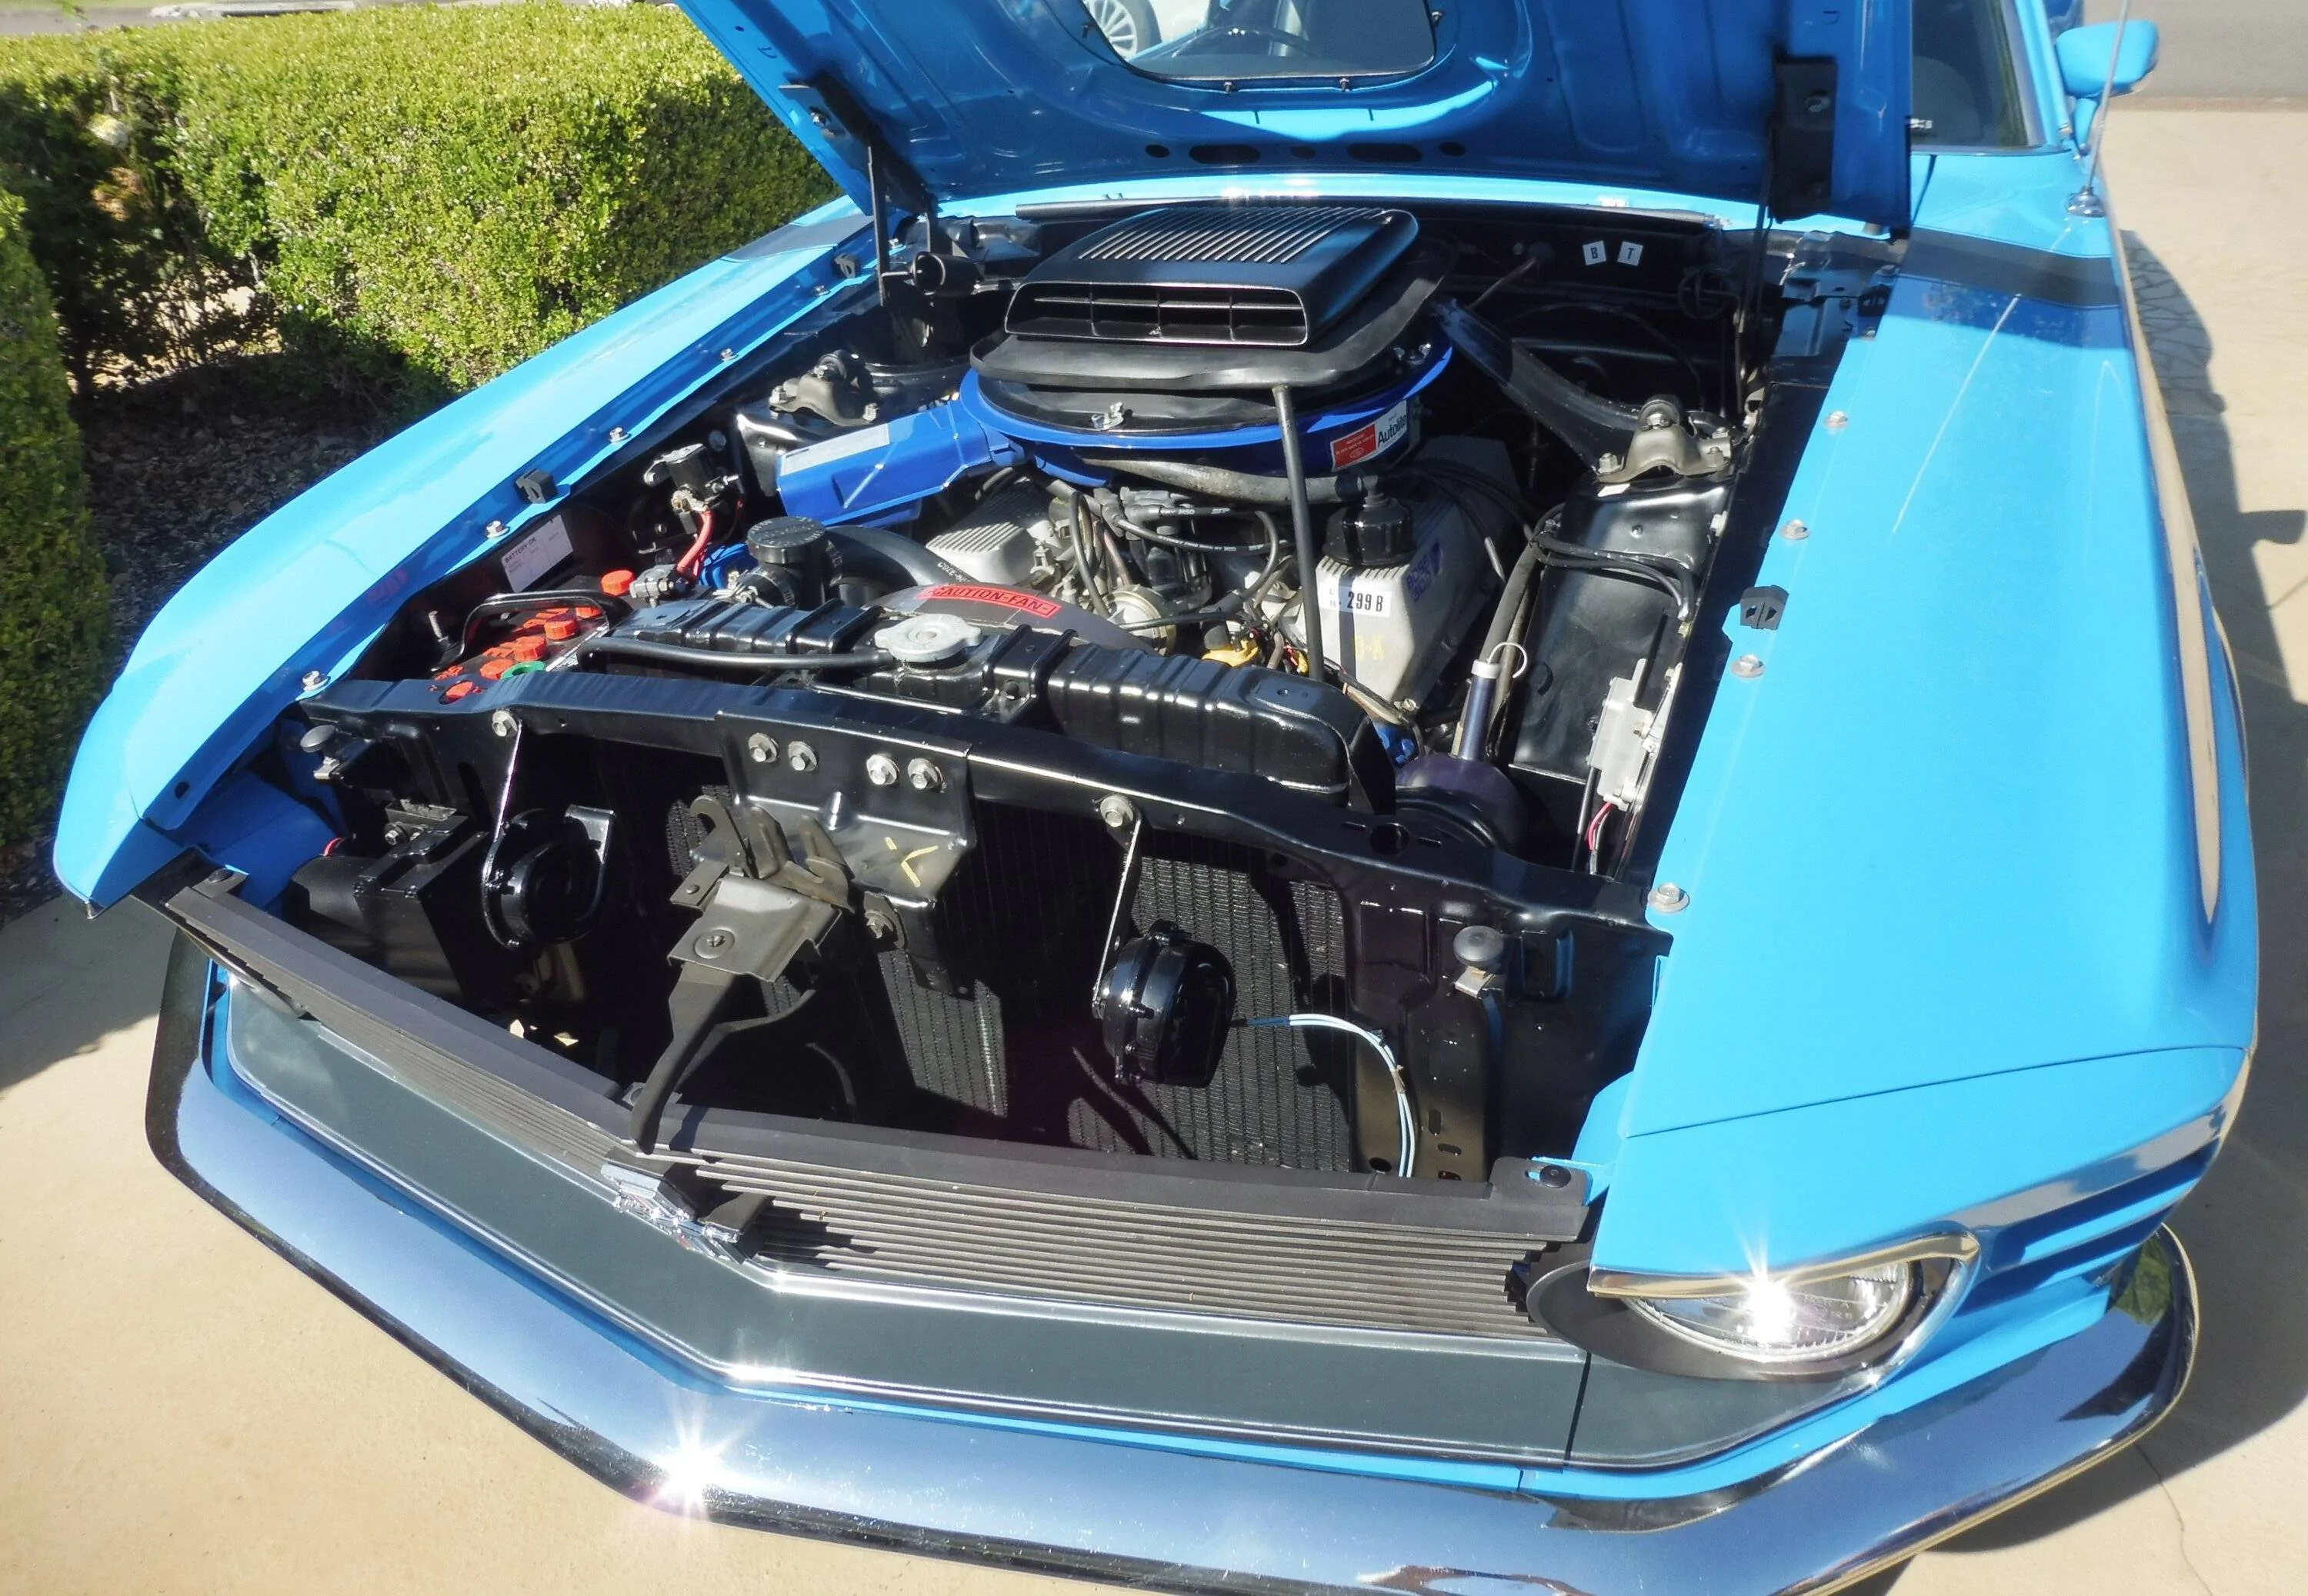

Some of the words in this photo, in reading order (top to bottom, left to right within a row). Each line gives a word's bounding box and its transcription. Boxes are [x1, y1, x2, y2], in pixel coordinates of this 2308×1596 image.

[1590, 247, 1599, 259] B
[1627, 247, 1635, 260] T
[505, 544, 527, 563] BATTERY
[1347, 591, 1372, 611] 299
[1376, 595, 1383, 612] B
